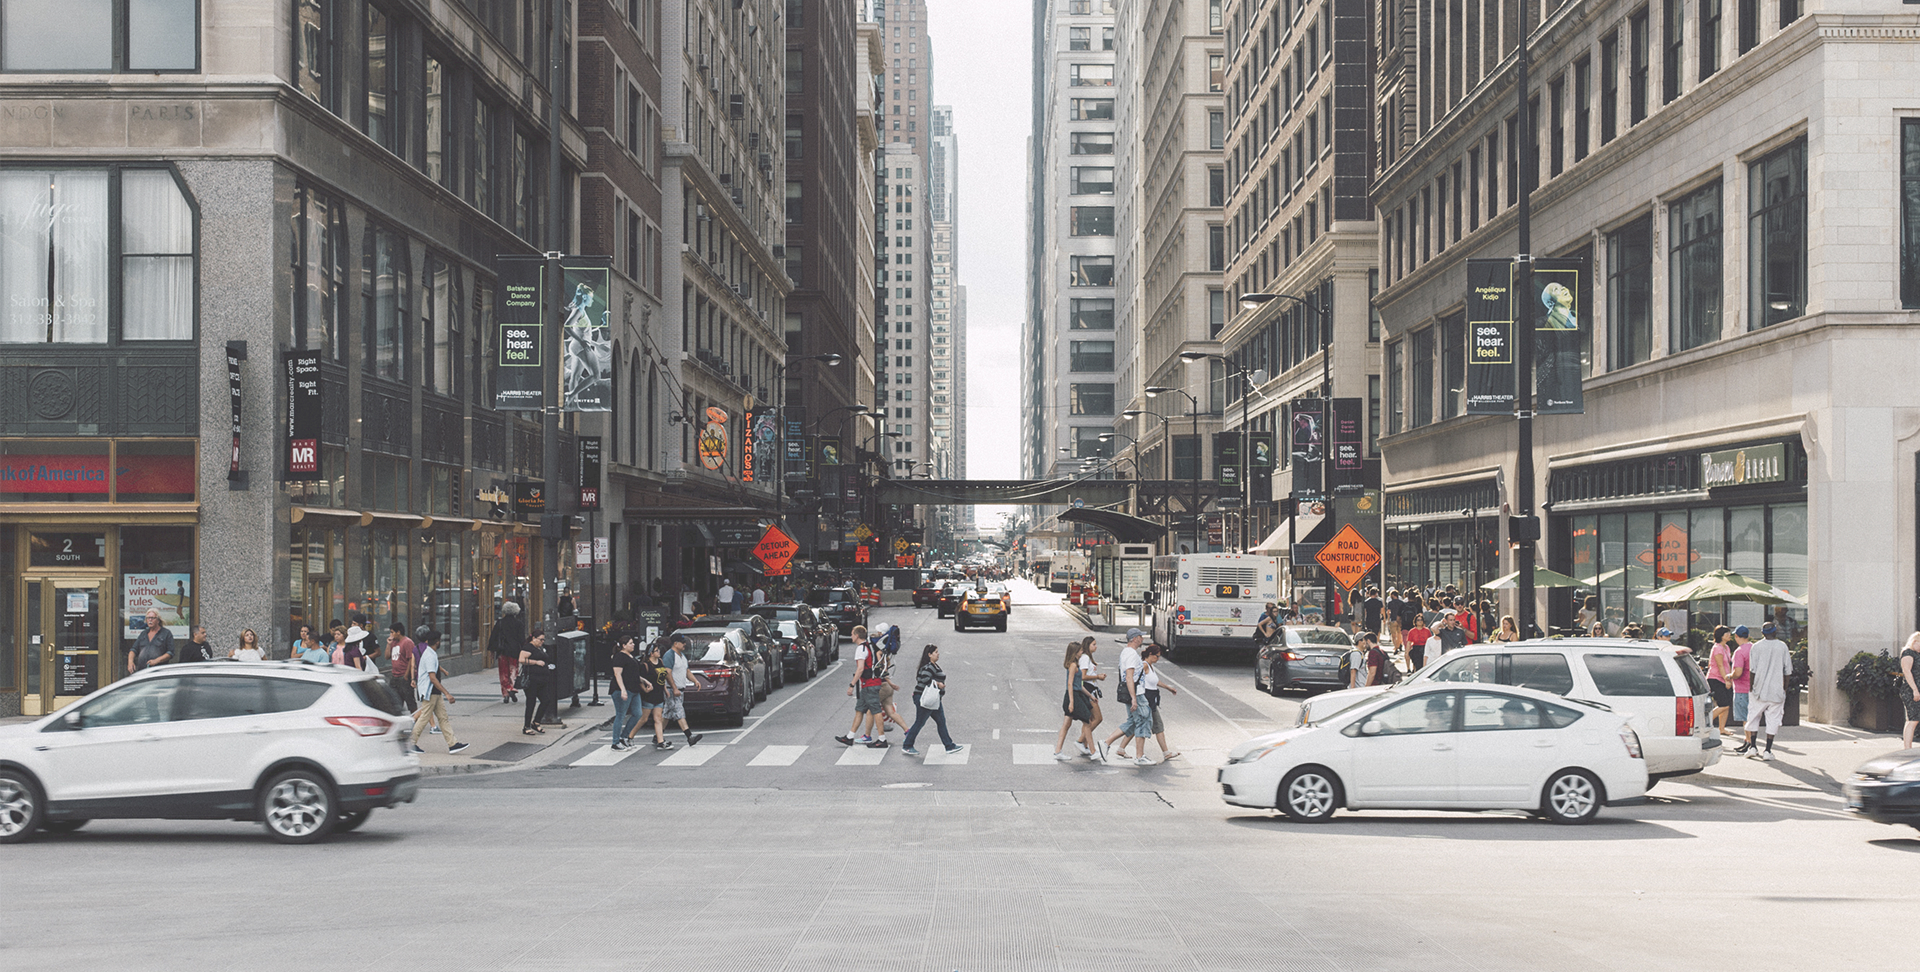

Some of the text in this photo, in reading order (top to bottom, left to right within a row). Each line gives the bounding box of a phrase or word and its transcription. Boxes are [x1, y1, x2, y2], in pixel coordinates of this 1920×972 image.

[131, 106, 195, 120] PARIS
[1475, 286, 1506, 294] Angélique
[10, 294, 96, 310] Salon & Spa
[506, 330, 529, 338] see.
[1476, 327, 1500, 336] see.
[506, 339, 533, 349] hear.
[1476, 336, 1504, 346] hear.
[506, 350, 529, 360] feel.
[1476, 347, 1500, 357] feel.
[298, 358, 316, 366] Right
[296, 366, 318, 374] Space.
[299, 381, 316, 389] Right
[292, 448, 314, 463] MR
[18, 465, 35, 481] of
[37, 465, 105, 481] America
[582, 493, 595, 502] MR
[63, 539, 72, 552] 2
[761, 541, 789, 550] DETOUR
[1338, 541, 1359, 549] ROAD
[764, 551, 789, 560] AHEAD
[1321, 553, 1376, 562] CONSTRUCTION
[1336, 565, 1362, 574] AHEAD
[129, 576, 157, 586] Travel
[129, 586, 167, 596] without
[1222, 586, 1232, 594] 20
[129, 598, 153, 606] rules
